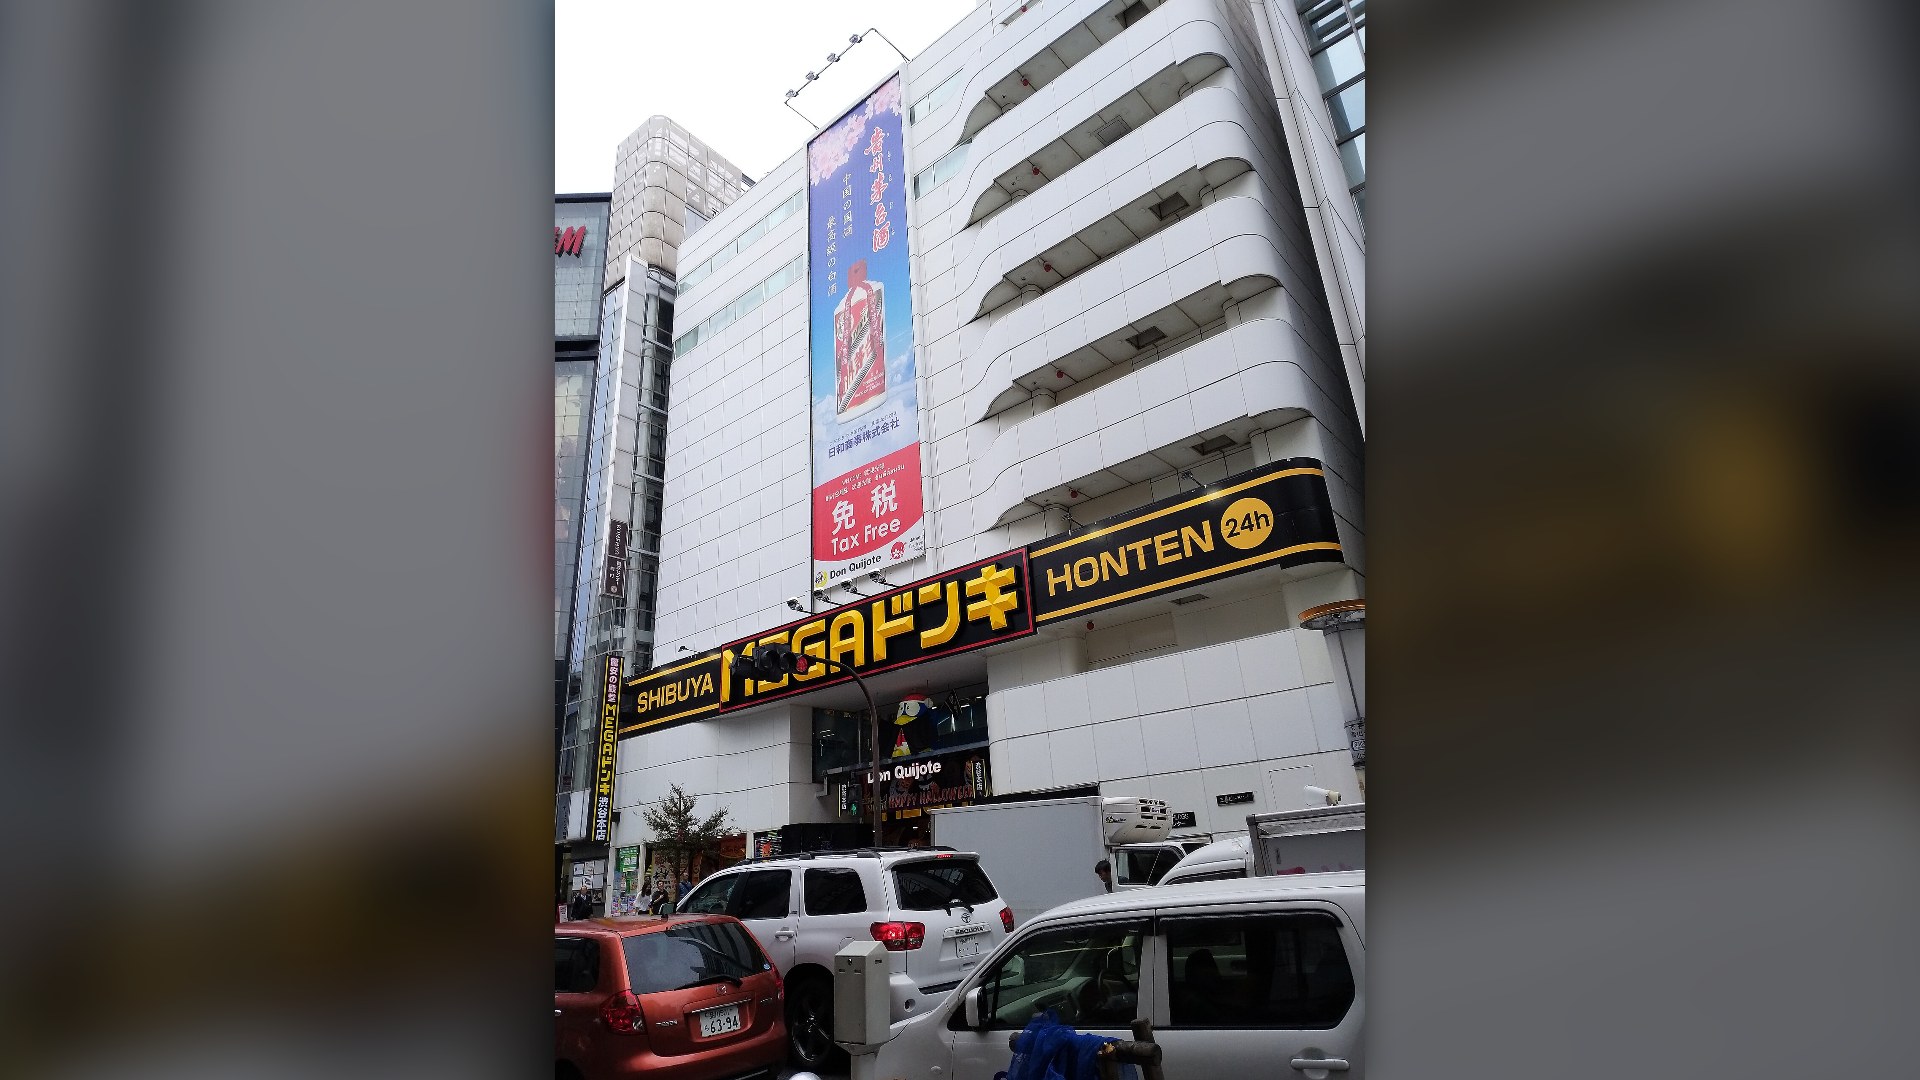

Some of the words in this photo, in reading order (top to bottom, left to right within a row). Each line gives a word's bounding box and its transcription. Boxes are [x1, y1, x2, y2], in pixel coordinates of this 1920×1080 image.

[555, 225, 586, 255] M
[831, 479, 899, 536] 免税
[831, 532, 860, 556] Tax
[864, 518, 901, 544] Free
[1046, 520, 1215, 597] HONTEN
[1225, 510, 1272, 539] 24h
[829, 566, 847, 580] Don
[849, 553, 882, 572] Quijote
[637, 672, 714, 713] SHIBUYA
[599, 703, 617, 796] MEGAドンキ
[894, 760, 942, 780] Quijote
[710, 1015, 738, 1033] 63-94
